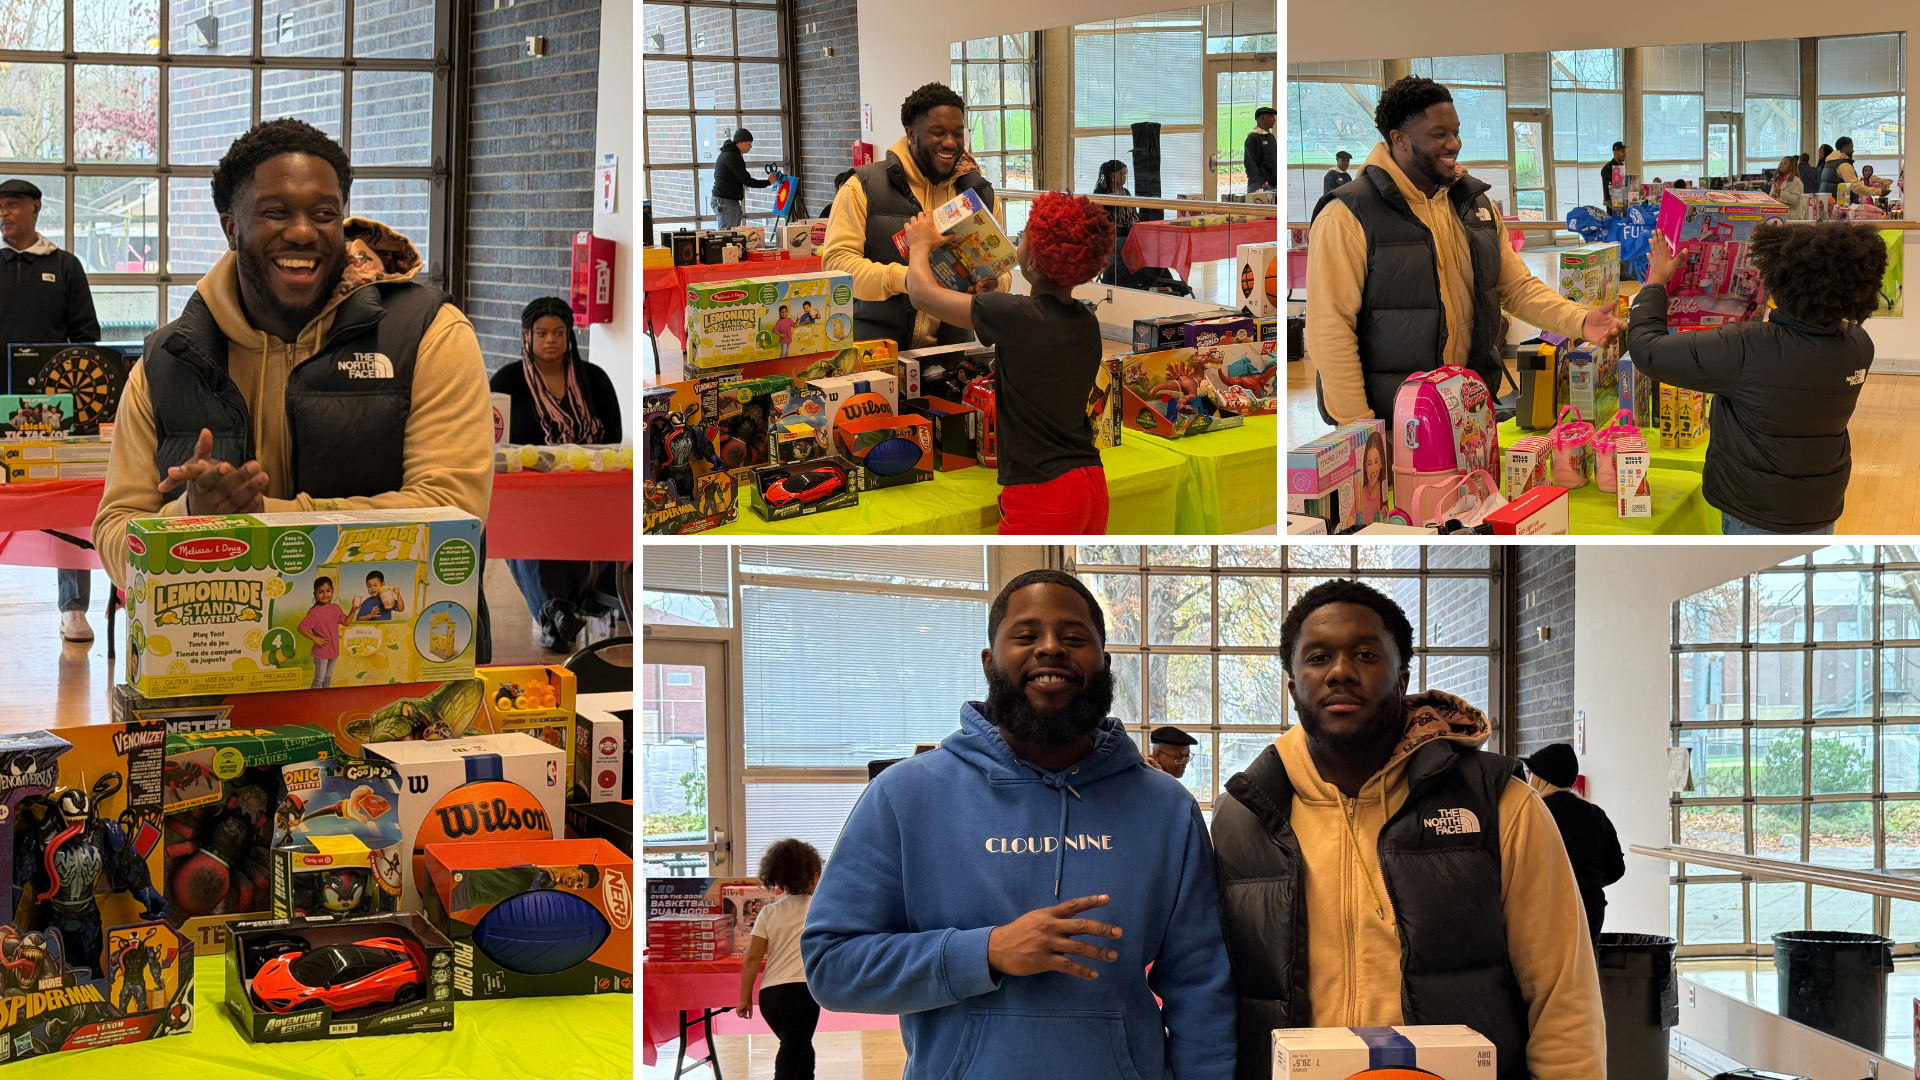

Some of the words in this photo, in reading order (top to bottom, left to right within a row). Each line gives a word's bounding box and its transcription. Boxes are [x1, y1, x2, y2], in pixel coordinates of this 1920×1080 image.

[599, 270, 608, 302] FIRE
[1667, 297, 1700, 316] Barbie
[704, 309, 755, 328] LEMONADE
[718, 320, 743, 329] STAND
[760, 333, 766, 341] 4
[353, 352, 375, 361] THE
[338, 361, 375, 371] NORTH
[349, 370, 376, 379] FACE
[841, 401, 893, 420] Wilson
[20, 422, 52, 433] sticky
[5, 431, 24, 440] TIC
[25, 431, 46, 440] TAC
[919, 426, 931, 452] NERF
[338, 526, 418, 549] LEMONADE
[178, 545, 214, 557] Melissa
[222, 543, 243, 556] Doug
[156, 581, 262, 614] LEMONADE
[184, 602, 235, 616] STAND
[182, 616, 210, 625] PLAY
[210, 614, 237, 624] TENT
[193, 631, 208, 639] Play
[210, 630, 225, 638] Tent
[188, 640, 210, 648] Tente
[218, 640, 230, 648] jeu
[271, 634, 283, 649] 4
[210, 648, 242, 657] campaña
[199, 656, 226, 665] juguete
[218, 675, 226, 683] EN
[226, 673, 245, 682] GARDE
[166, 719, 231, 734] NSTER
[180, 729, 275, 740] TERRA
[114, 730, 165, 752] VENOMIZE!
[254, 752, 293, 766] INDIES.
[284, 768, 320, 783] ONIC
[435, 798, 551, 839] Wilson
[1438, 808, 1459, 818] THE
[1423, 817, 1461, 828] NORTH
[1436, 825, 1463, 836] FACE
[985, 837, 1059, 854] CLOUD
[1064, 834, 1113, 851] NINE
[305, 857, 318, 865] Only
[275, 855, 287, 900] HEROES
[650, 885, 675, 894] LED
[604, 869, 628, 927] NERF
[650, 900, 717, 908] BASKETBALL
[650, 908, 679, 916] DUAL
[680, 907, 710, 916] HOOP
[454, 941, 474, 968] PRO
[38, 976, 63, 991] MARVEL
[454, 966, 474, 998] GRIP
[0, 984, 105, 1031] SPIDER-MAN
[264, 1012, 323, 1032] ADVENTURE
[379, 1010, 424, 1024] McLaren
[96, 1021, 124, 1032] VENOM
[280, 1020, 322, 1034] FORCE
[1477, 1050, 1491, 1059] DRV
[1315, 1058, 1320, 1067] 7
[1477, 1059, 1491, 1067] NBA
